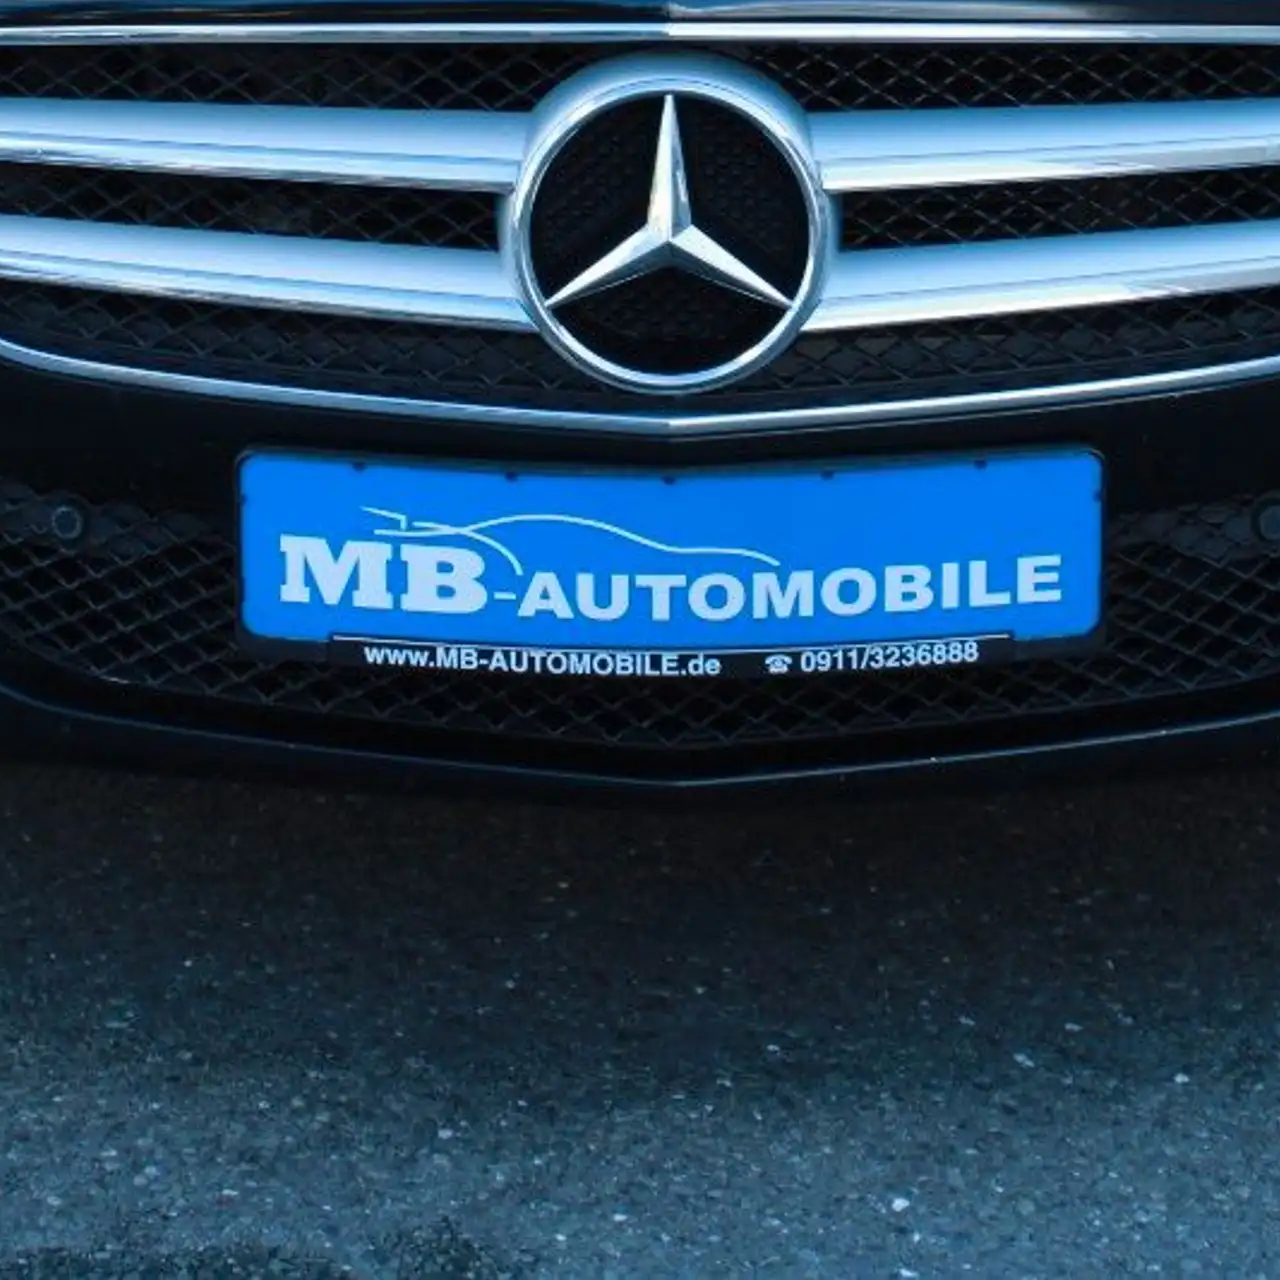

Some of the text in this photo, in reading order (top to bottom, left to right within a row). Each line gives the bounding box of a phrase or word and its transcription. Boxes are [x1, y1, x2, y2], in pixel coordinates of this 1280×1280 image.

[279, 534, 1062, 621] MB-AUTOMOBILE
[363, 641, 978, 676] www.MB-AUTOMOBILE.de 0911/3236888
